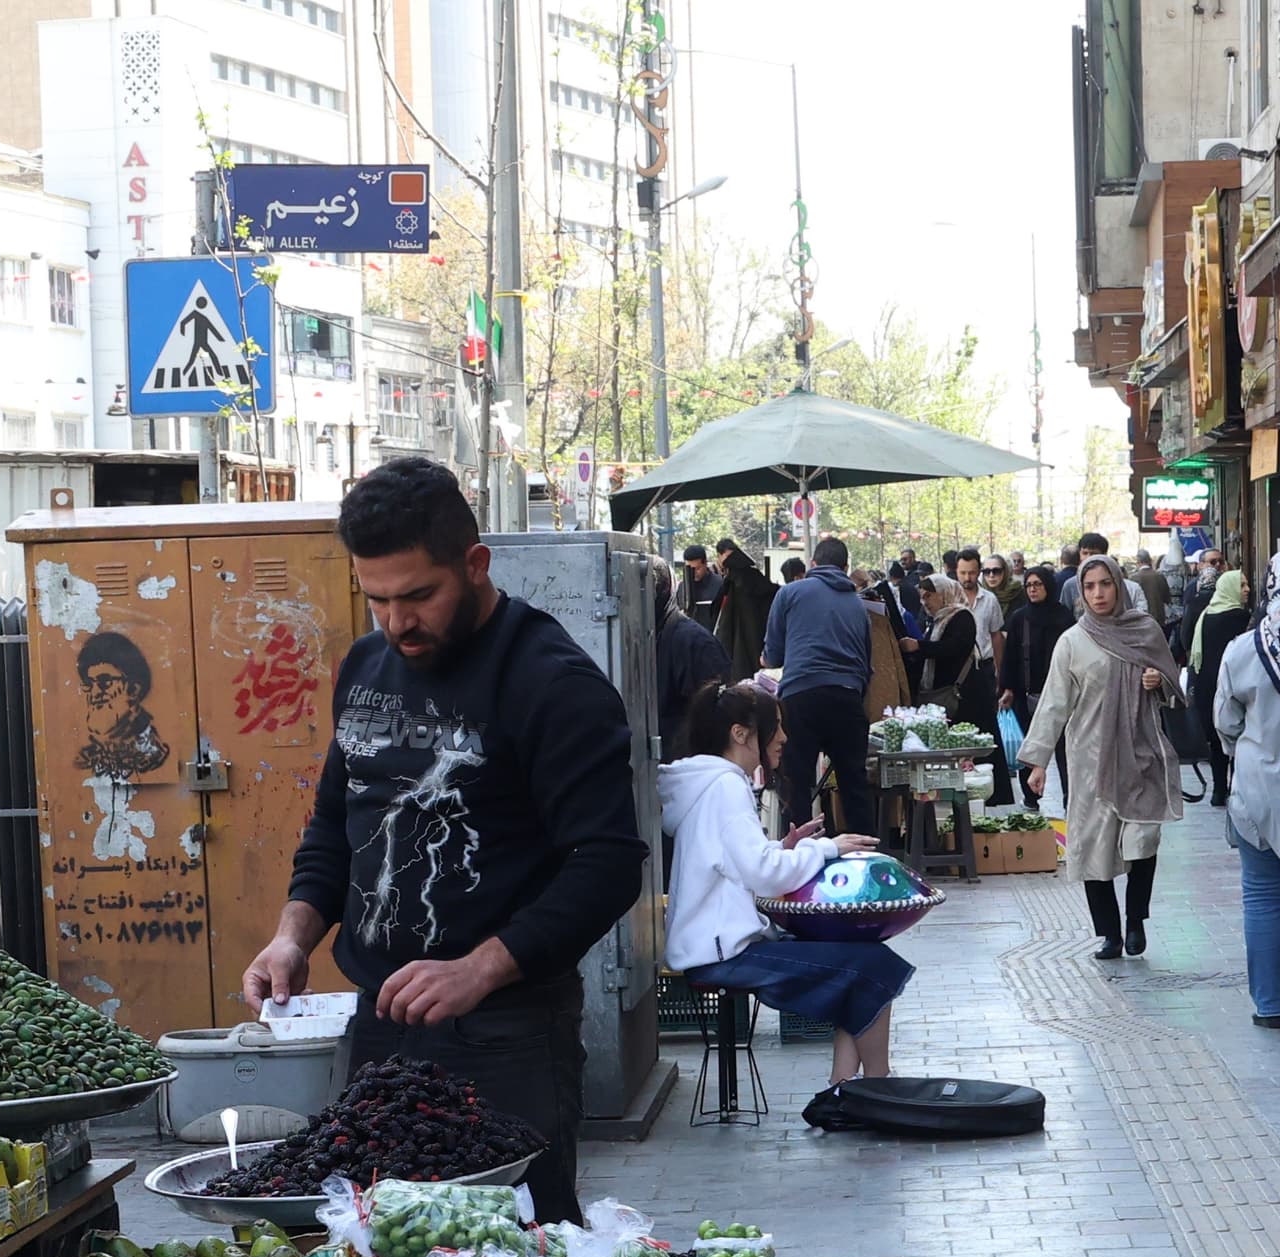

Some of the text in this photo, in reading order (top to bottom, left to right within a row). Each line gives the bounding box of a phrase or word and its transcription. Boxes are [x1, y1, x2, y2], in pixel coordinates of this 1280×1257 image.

[357, 170, 385, 185] کوچه
[265, 187, 360, 229] زعیم
[53, 857, 131, 879] پسرانه
